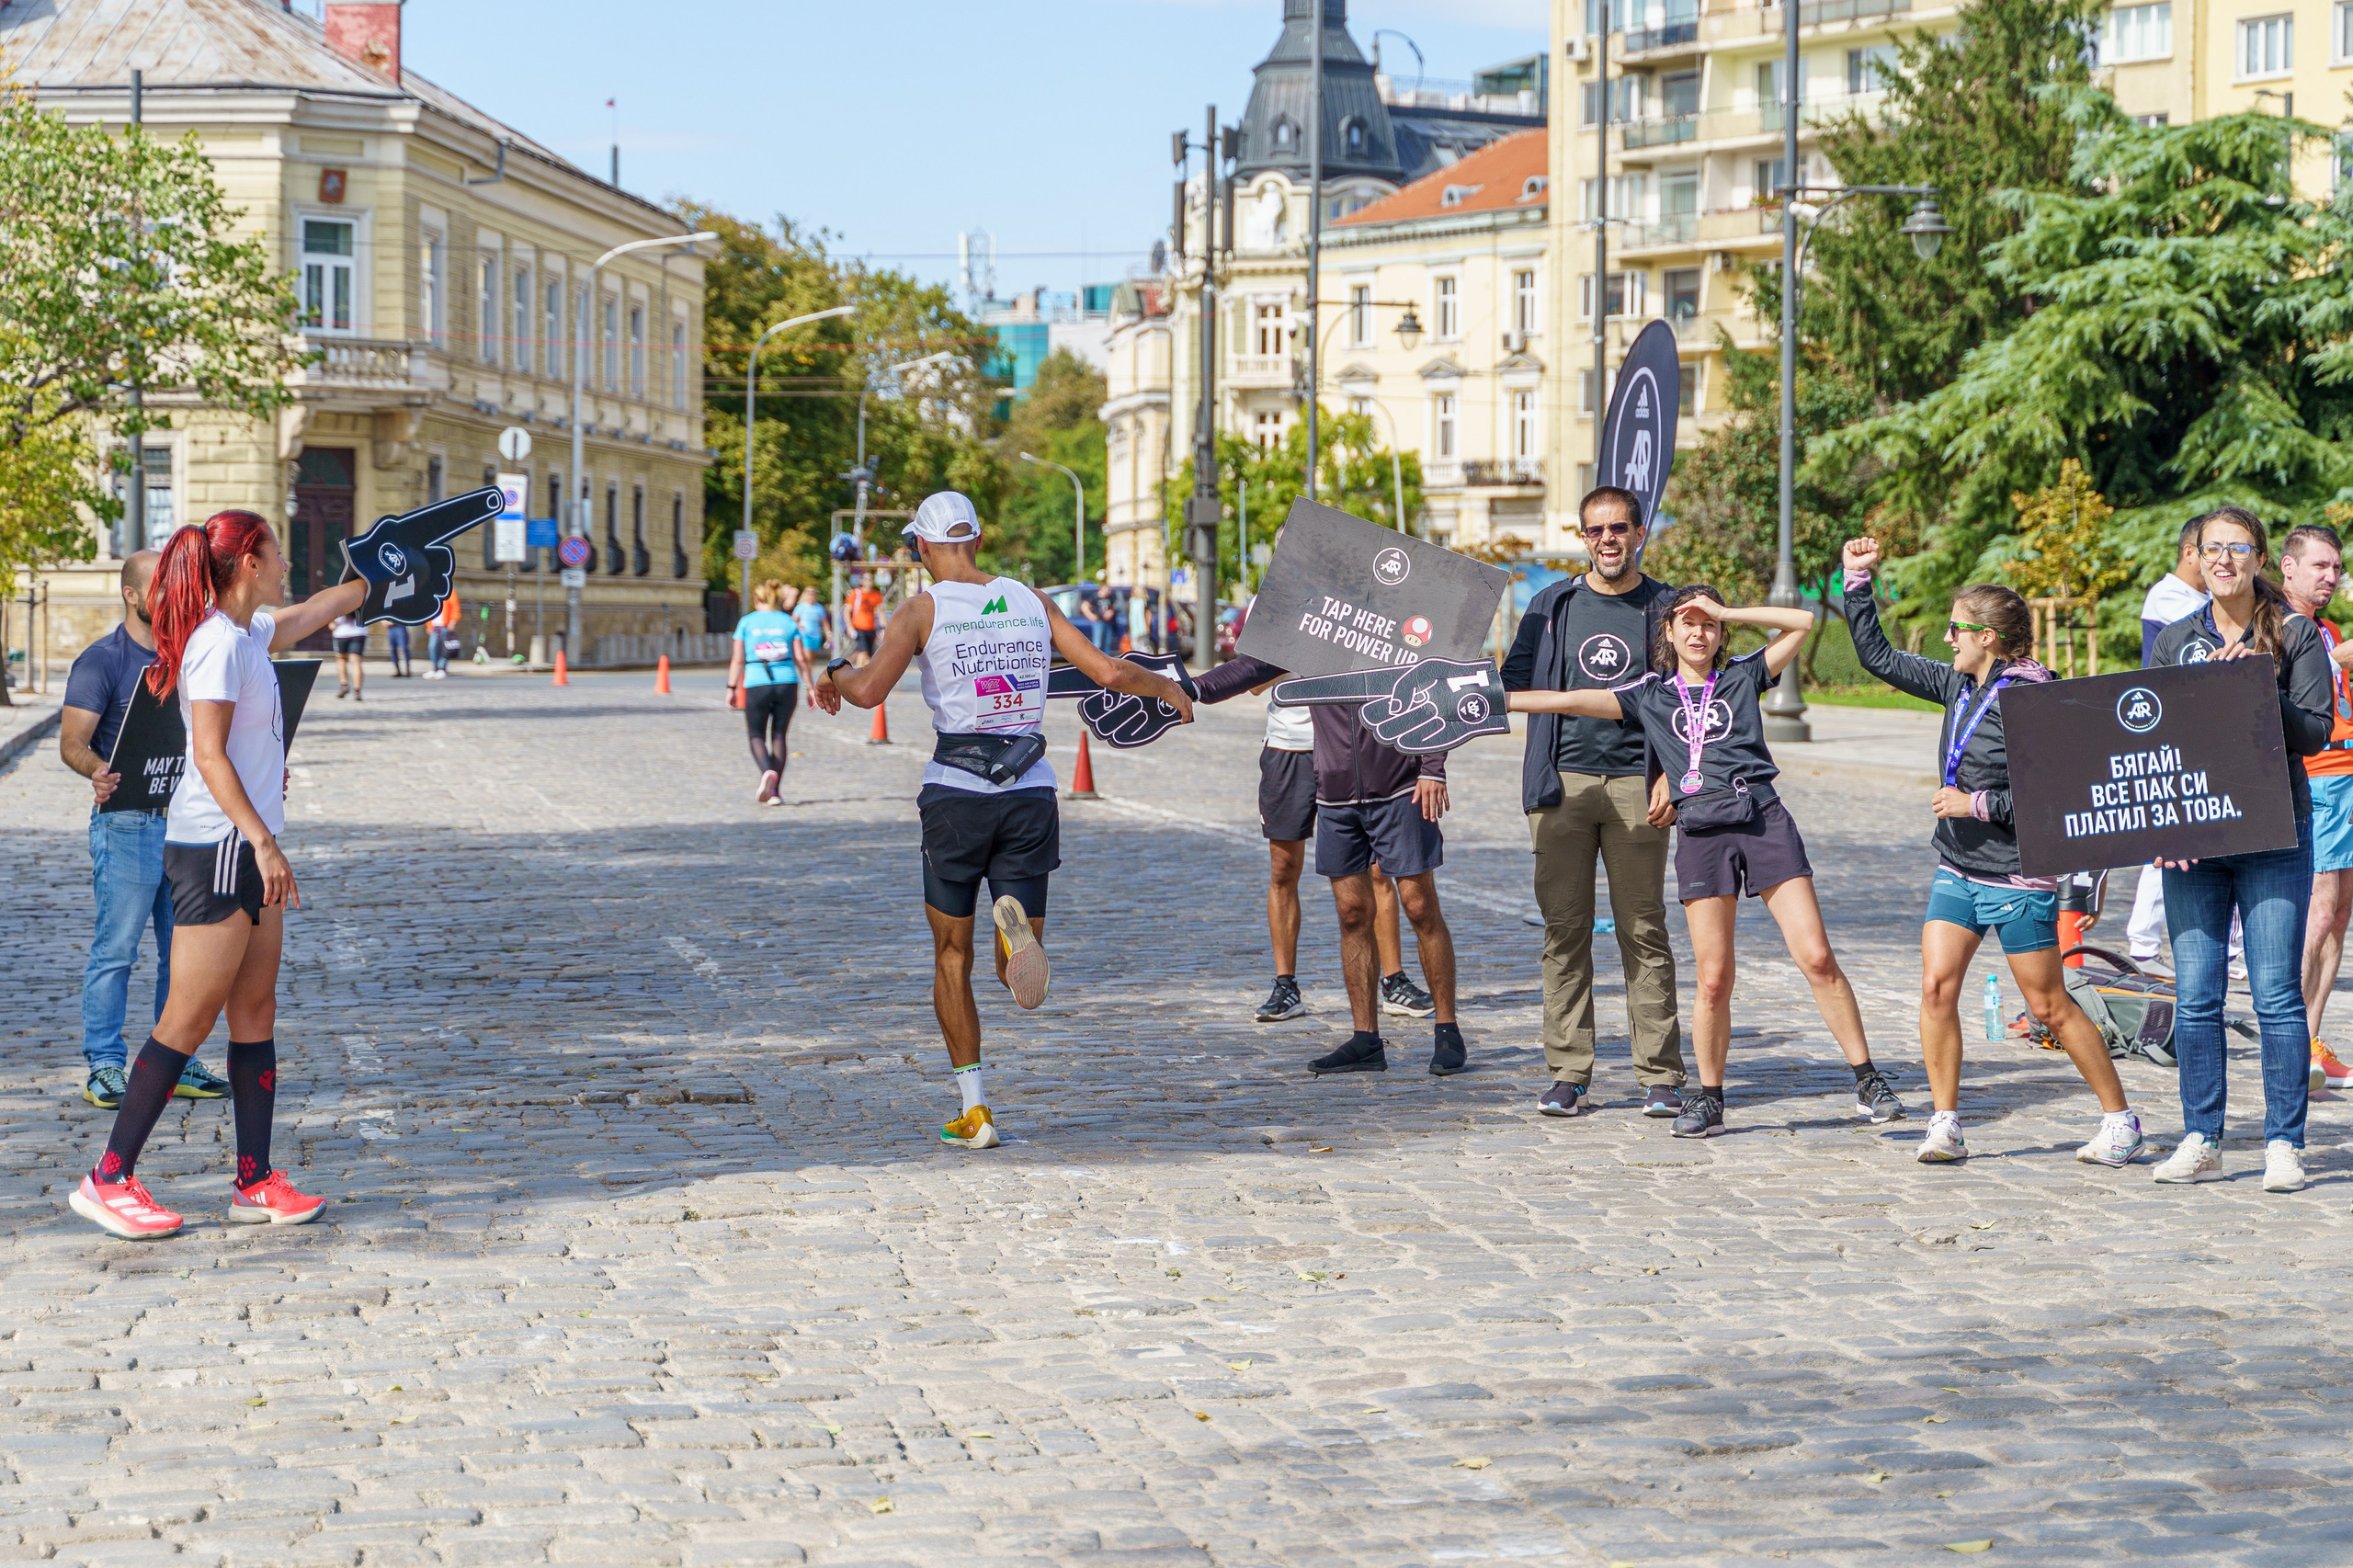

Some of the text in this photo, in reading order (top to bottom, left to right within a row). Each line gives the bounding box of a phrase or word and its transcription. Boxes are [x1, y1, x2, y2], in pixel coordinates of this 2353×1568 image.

[944, 617, 1044, 634] myendurance.life
[1321, 596, 1397, 640] TAP HERE
[955, 640, 1043, 660] Endurance
[1298, 612, 1419, 666] FOR POWER UP
[951, 653, 1047, 677] Nutritionist
[993, 692, 1024, 710] 334
[143, 756, 175, 776] MAY
[2109, 744, 2183, 778] БЯГАЙ!
[148, 776, 168, 795] BE
[2091, 770, 2209, 807] ВСЕ ПАК СИ
[2064, 795, 2243, 837] ПЛАТИЛ ЗА ТОВА.
